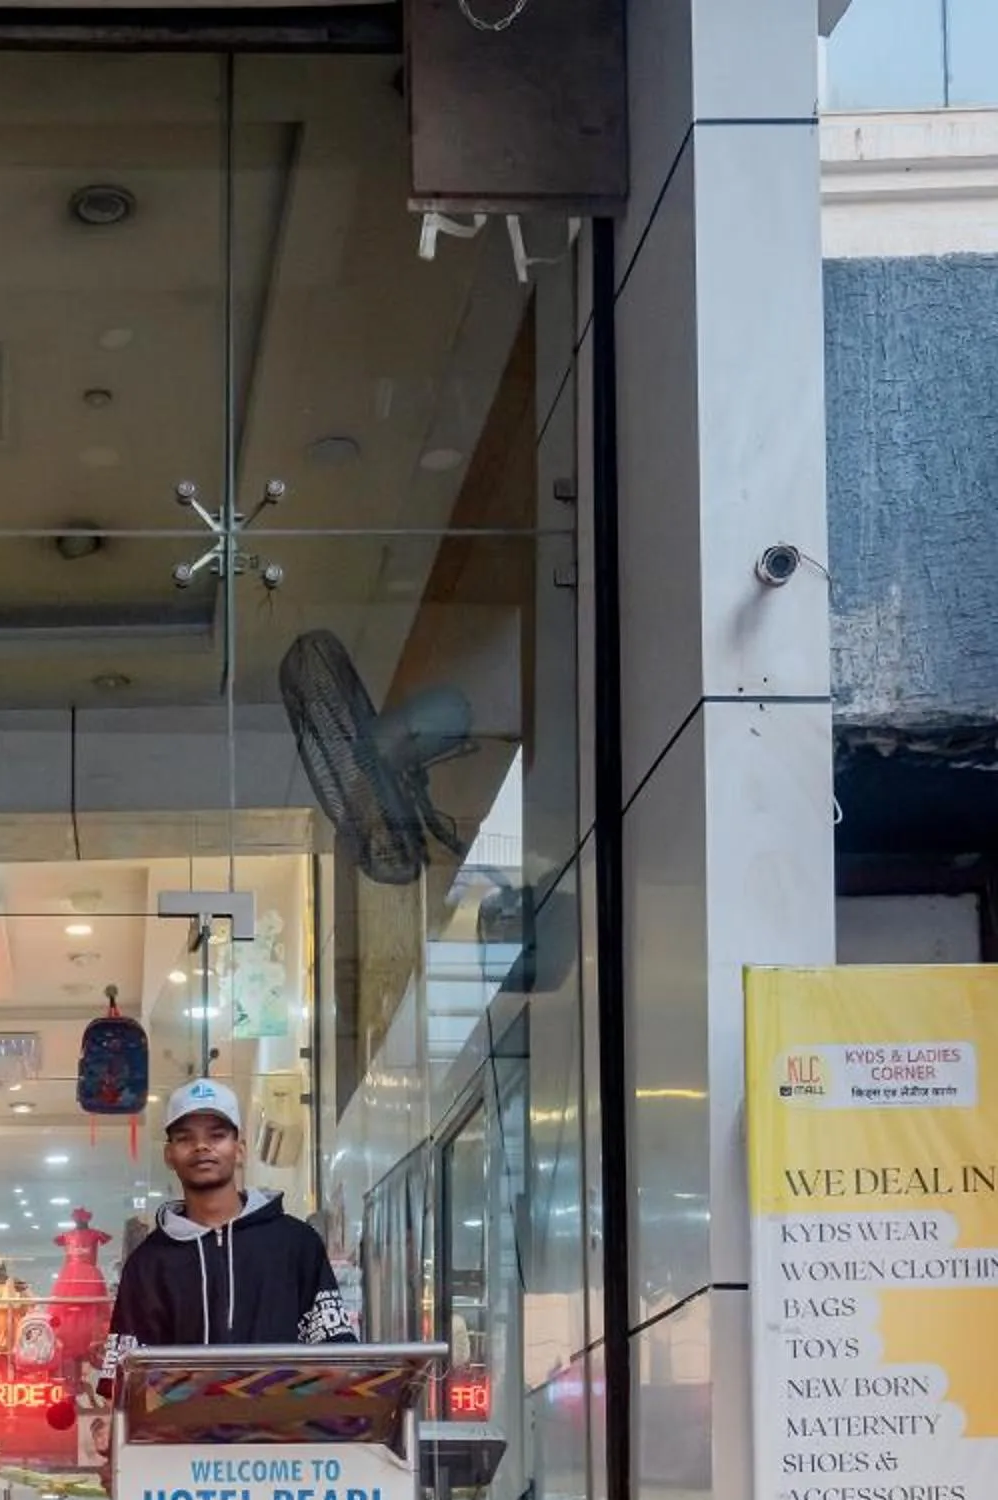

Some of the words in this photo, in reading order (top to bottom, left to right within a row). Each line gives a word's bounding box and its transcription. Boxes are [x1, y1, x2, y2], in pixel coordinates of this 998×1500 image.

[845, 1050, 885, 1064] KYDS
[891, 1050, 903, 1063] &
[907, 1048, 961, 1063] LADIES
[788, 1056, 820, 1083] KLC
[871, 1065, 936, 1081] CORNER
[785, 1169, 845, 1197] WE
[854, 1167, 952, 1195] DEAL
[961, 1165, 997, 1193] IN
[781, 1223, 852, 1243] KYDS
[858, 1221, 939, 1241] WEAR
[781, 1259, 885, 1281] WOMEN
[783, 1297, 856, 1319] BAGS
[786, 1337, 859, 1359] TOYS
[787, 1377, 848, 1399] NEW
[855, 1376, 930, 1397] BORN
[786, 1414, 941, 1438] MATERNITY
[192, 1460, 303, 1483] WELCOME
[312, 1460, 341, 1481] TO
[782, 1453, 870, 1473] SHOES
[875, 1451, 898, 1471] &
